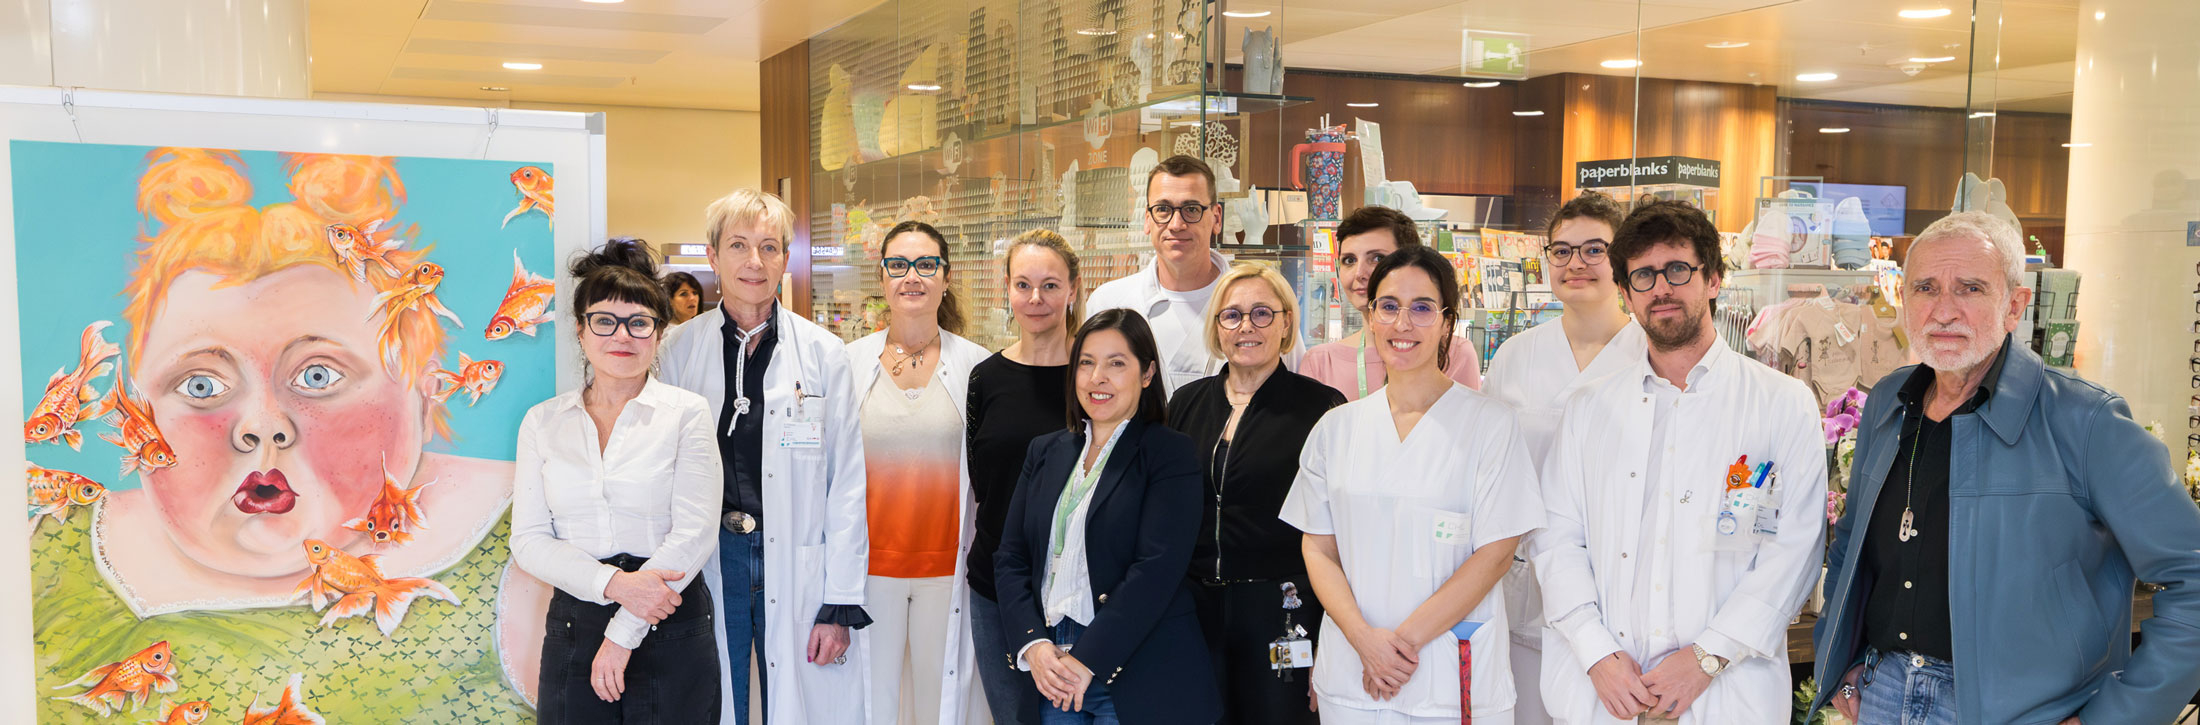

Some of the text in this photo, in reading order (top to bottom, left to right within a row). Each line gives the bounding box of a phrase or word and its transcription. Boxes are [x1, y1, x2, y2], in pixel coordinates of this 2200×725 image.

[1088, 150, 1108, 165] ZONE
[1580, 162, 1668, 183] paperblanks
[1678, 162, 1719, 179] paperblanks
[1503, 233, 1540, 249] buda
